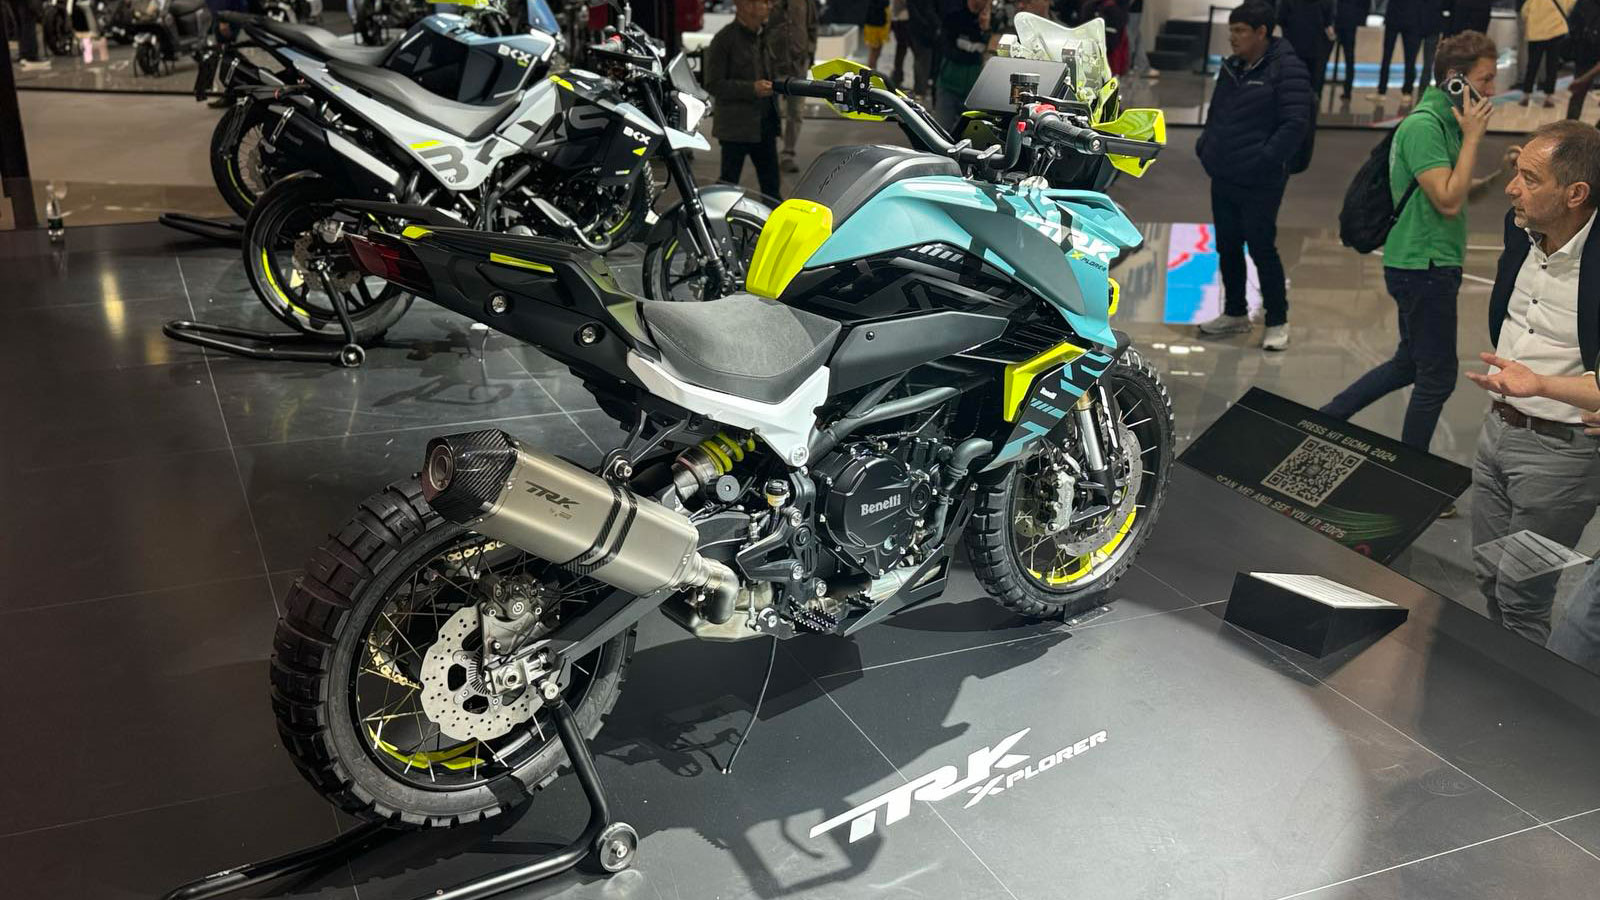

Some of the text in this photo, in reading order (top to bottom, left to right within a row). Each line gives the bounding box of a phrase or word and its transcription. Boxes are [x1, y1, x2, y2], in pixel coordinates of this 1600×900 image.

[1297, 420, 1398, 463] PRESS KIT EICMA 2024
[525, 480, 580, 510] TRK
[860, 493, 901, 517] Benelli
[1216, 474, 1239, 490] SCAN
[1253, 491, 1273, 505] AND
[1290, 507, 1308, 522] YOU
[1319, 522, 1348, 540] 2025
[809, 727, 1031, 843] TRK
[963, 729, 1108, 809] XPLORER
